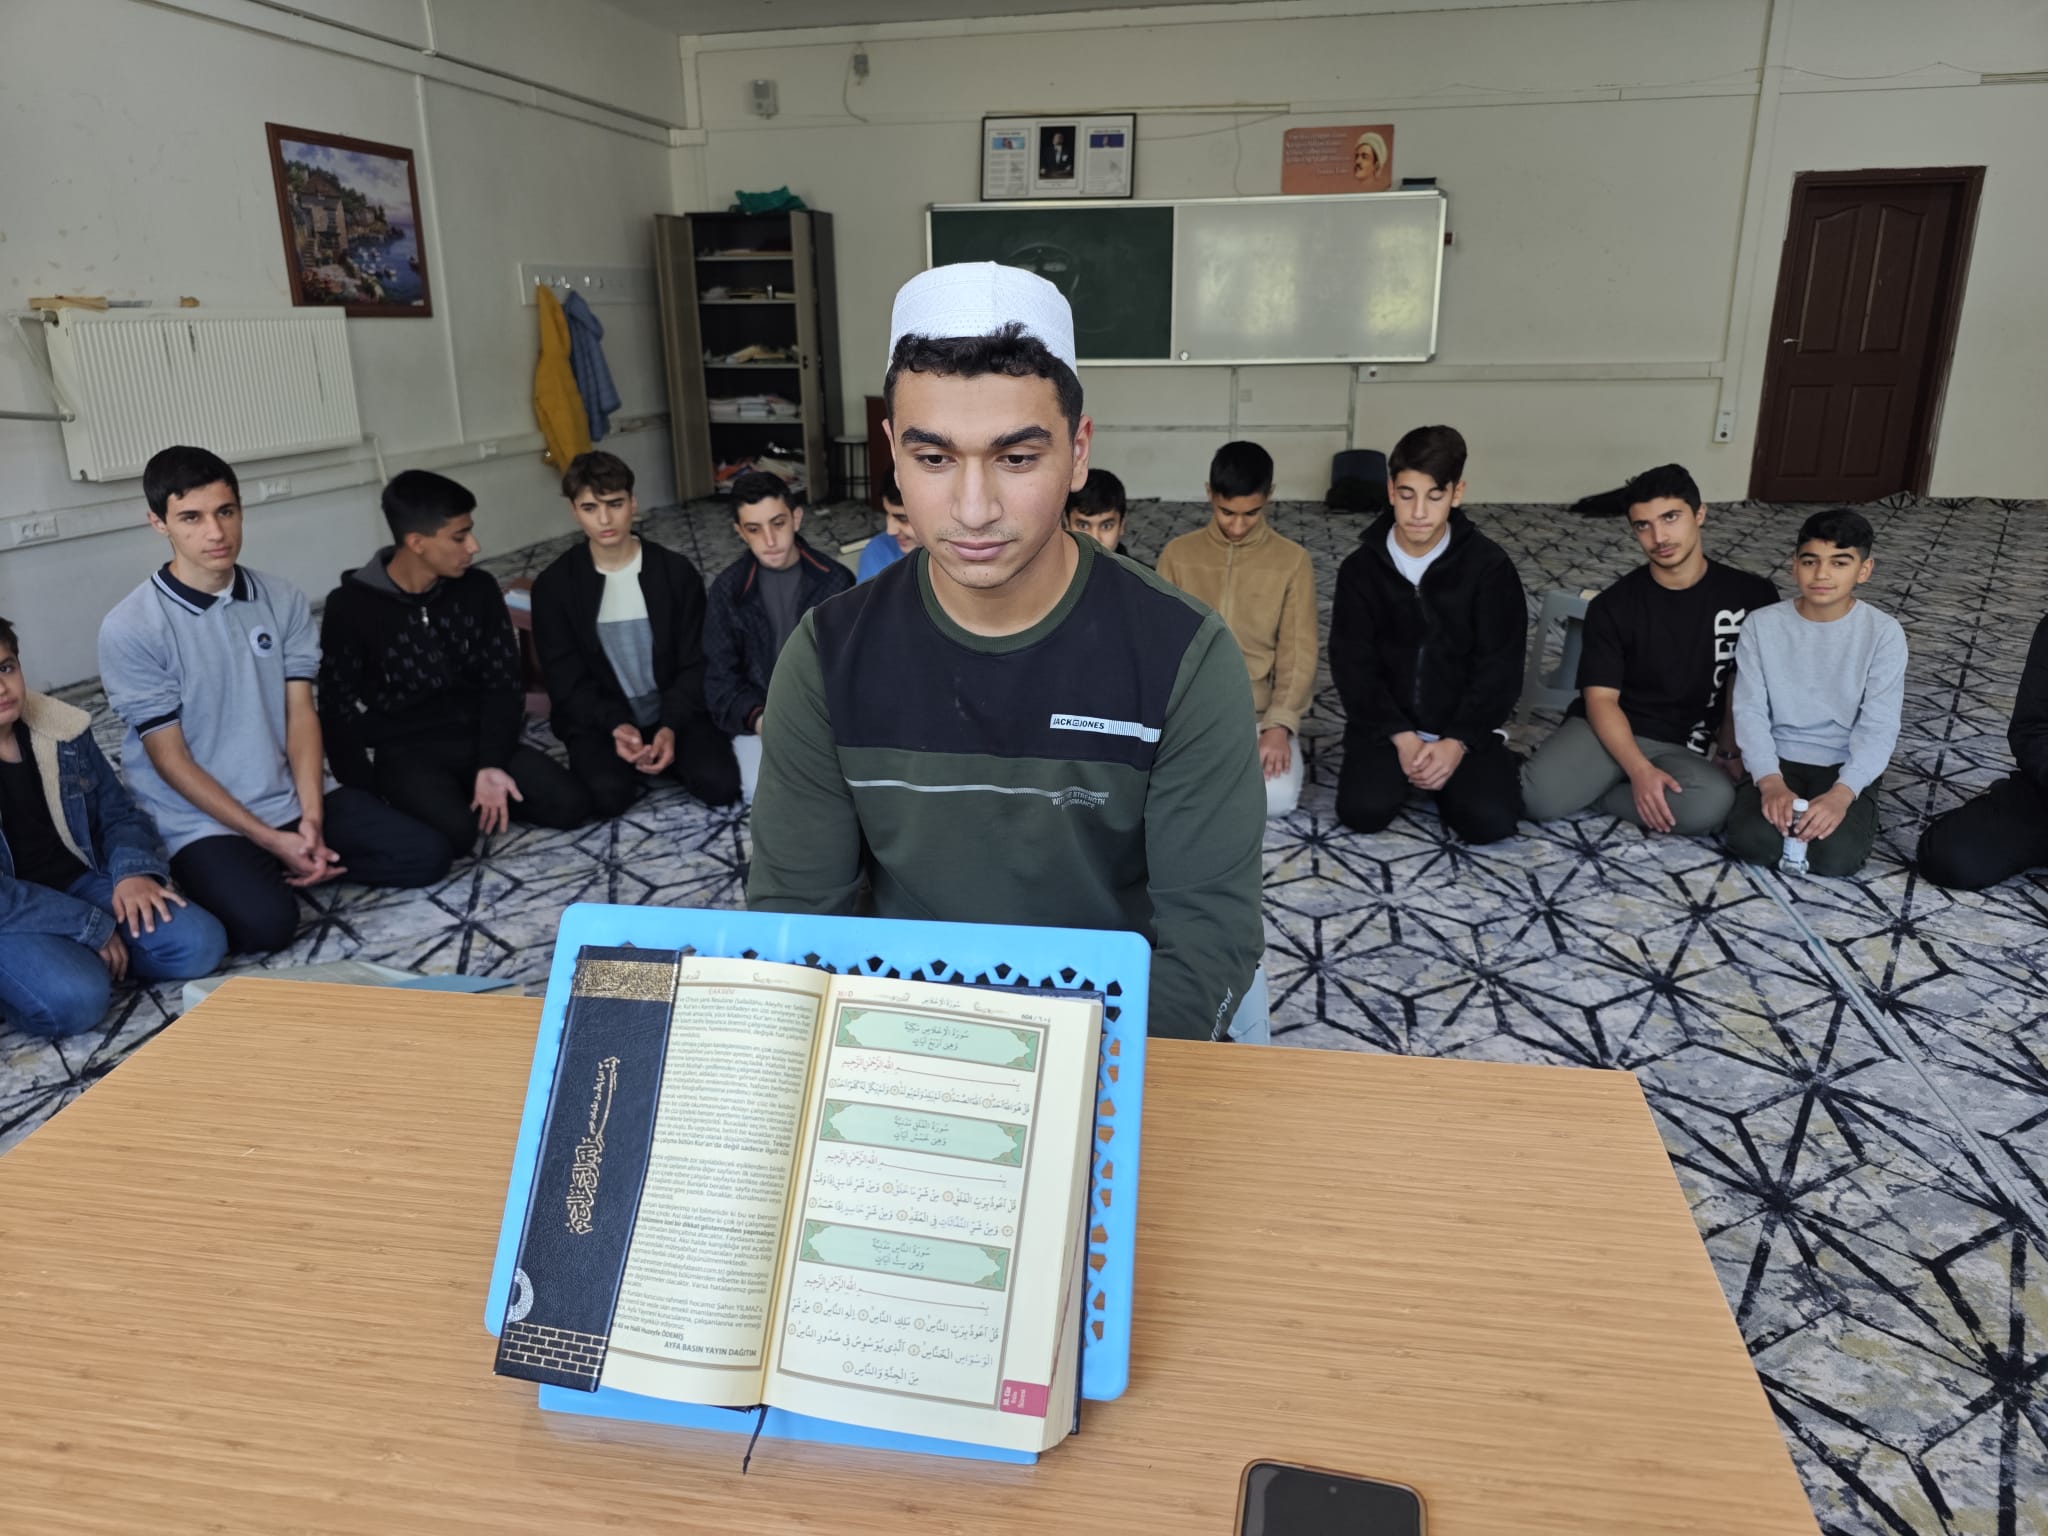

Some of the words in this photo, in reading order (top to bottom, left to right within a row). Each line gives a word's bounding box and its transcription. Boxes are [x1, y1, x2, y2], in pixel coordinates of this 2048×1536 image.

[664, 1341, 681, 1350] AYFA
[682, 1343, 704, 1353] BASIN
[704, 1346, 727, 1356] YAYIN
